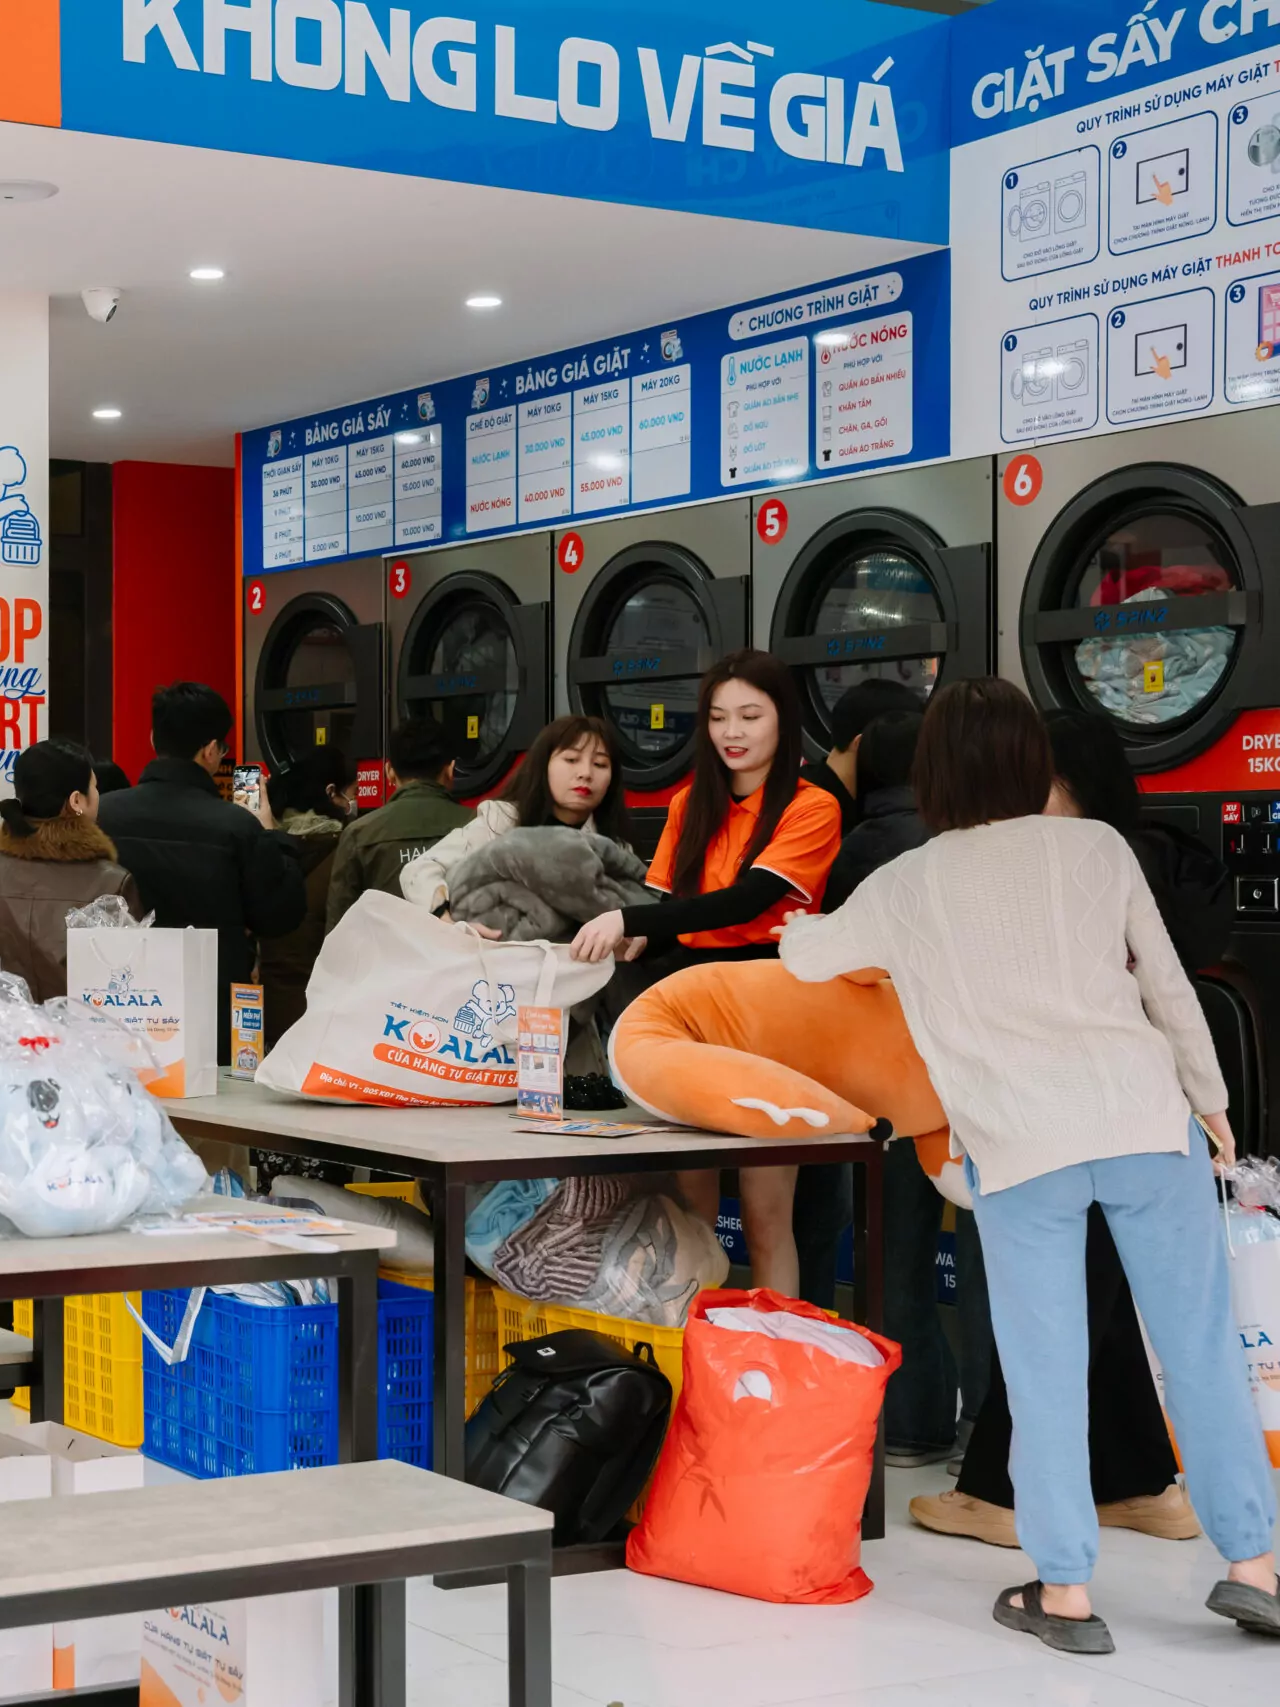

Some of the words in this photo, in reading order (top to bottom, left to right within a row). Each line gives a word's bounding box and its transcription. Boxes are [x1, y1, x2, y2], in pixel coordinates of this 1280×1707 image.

[971, 44, 1075, 120] GIẶT
[1086, 0, 1186, 84] SẤY
[495, 24, 619, 132] LO
[637, 40, 774, 152] VỀ
[769, 56, 904, 172] GIÁ
[1076, 116, 1102, 134] QUY
[1105, 104, 1141, 125] TRÌNH
[1144, 94, 1162, 112] SỬ
[1164, 85, 1202, 108] DỤNG
[1206, 74, 1234, 93] MÁY
[1238, 62, 1270, 84] GIẶT
[1029, 296, 1054, 311] QUY
[1057, 286, 1090, 305] TRÌNH
[1094, 278, 1111, 295] SỬ
[1112, 271, 1149, 293] DỤNG
[1151, 263, 1178, 283] MÁY
[1181, 257, 1213, 277] GIẶT
[1215, 248, 1261, 269] THANH
[749, 304, 803, 332] CHƯƠNG
[807, 292, 844, 317] TRÌNH
[848, 284, 880, 312] GIẶT
[870, 323, 907, 346] NÓNG
[516, 367, 558, 395] BẢNG
[561, 353, 590, 384] GIÁ
[593, 346, 631, 377] GIẶT
[740, 353, 771, 375] NƯỚC
[774, 349, 804, 368] LẠNH
[641, 377, 658, 392] MÁY
[659, 374, 680, 389] 20KG
[583, 392, 599, 405] MÁY
[601, 389, 619, 402] 15KG
[527, 405, 543, 418] MÁY
[544, 402, 561, 415] 10KG
[668, 411, 684, 425] VND
[305, 421, 339, 447] BẢNG
[342, 411, 365, 437] GIÁ
[367, 403, 392, 431] SẤY
[607, 425, 623, 437] VND
[356, 447, 369, 458] MÁY
[370, 443, 385, 455] 15KG
[311, 457, 324, 469] MÁY
[324, 454, 339, 466] 10KG
[422, 454, 435, 466] VND
[374, 465, 386, 477] VND
[329, 475, 341, 487] VND
[580, 480, 605, 493] 55.000
[606, 476, 623, 488] VND
[1014, 465, 1032, 495] 6
[491, 495, 511, 509] NÓNG
[524, 491, 549, 503] 40.000
[549, 487, 565, 499] VND
[357, 770, 380, 782] DRYER
[358, 785, 378, 796] 20KG
[383, 1014, 516, 1065] KOALAL
[387, 1047, 410, 1065] CỬA
[413, 1054, 446, 1076] HÀNG
[449, 1066, 462, 1081] TỰ
[465, 1066, 491, 1084] GIẶT
[493, 1072, 506, 1085] TỰ
